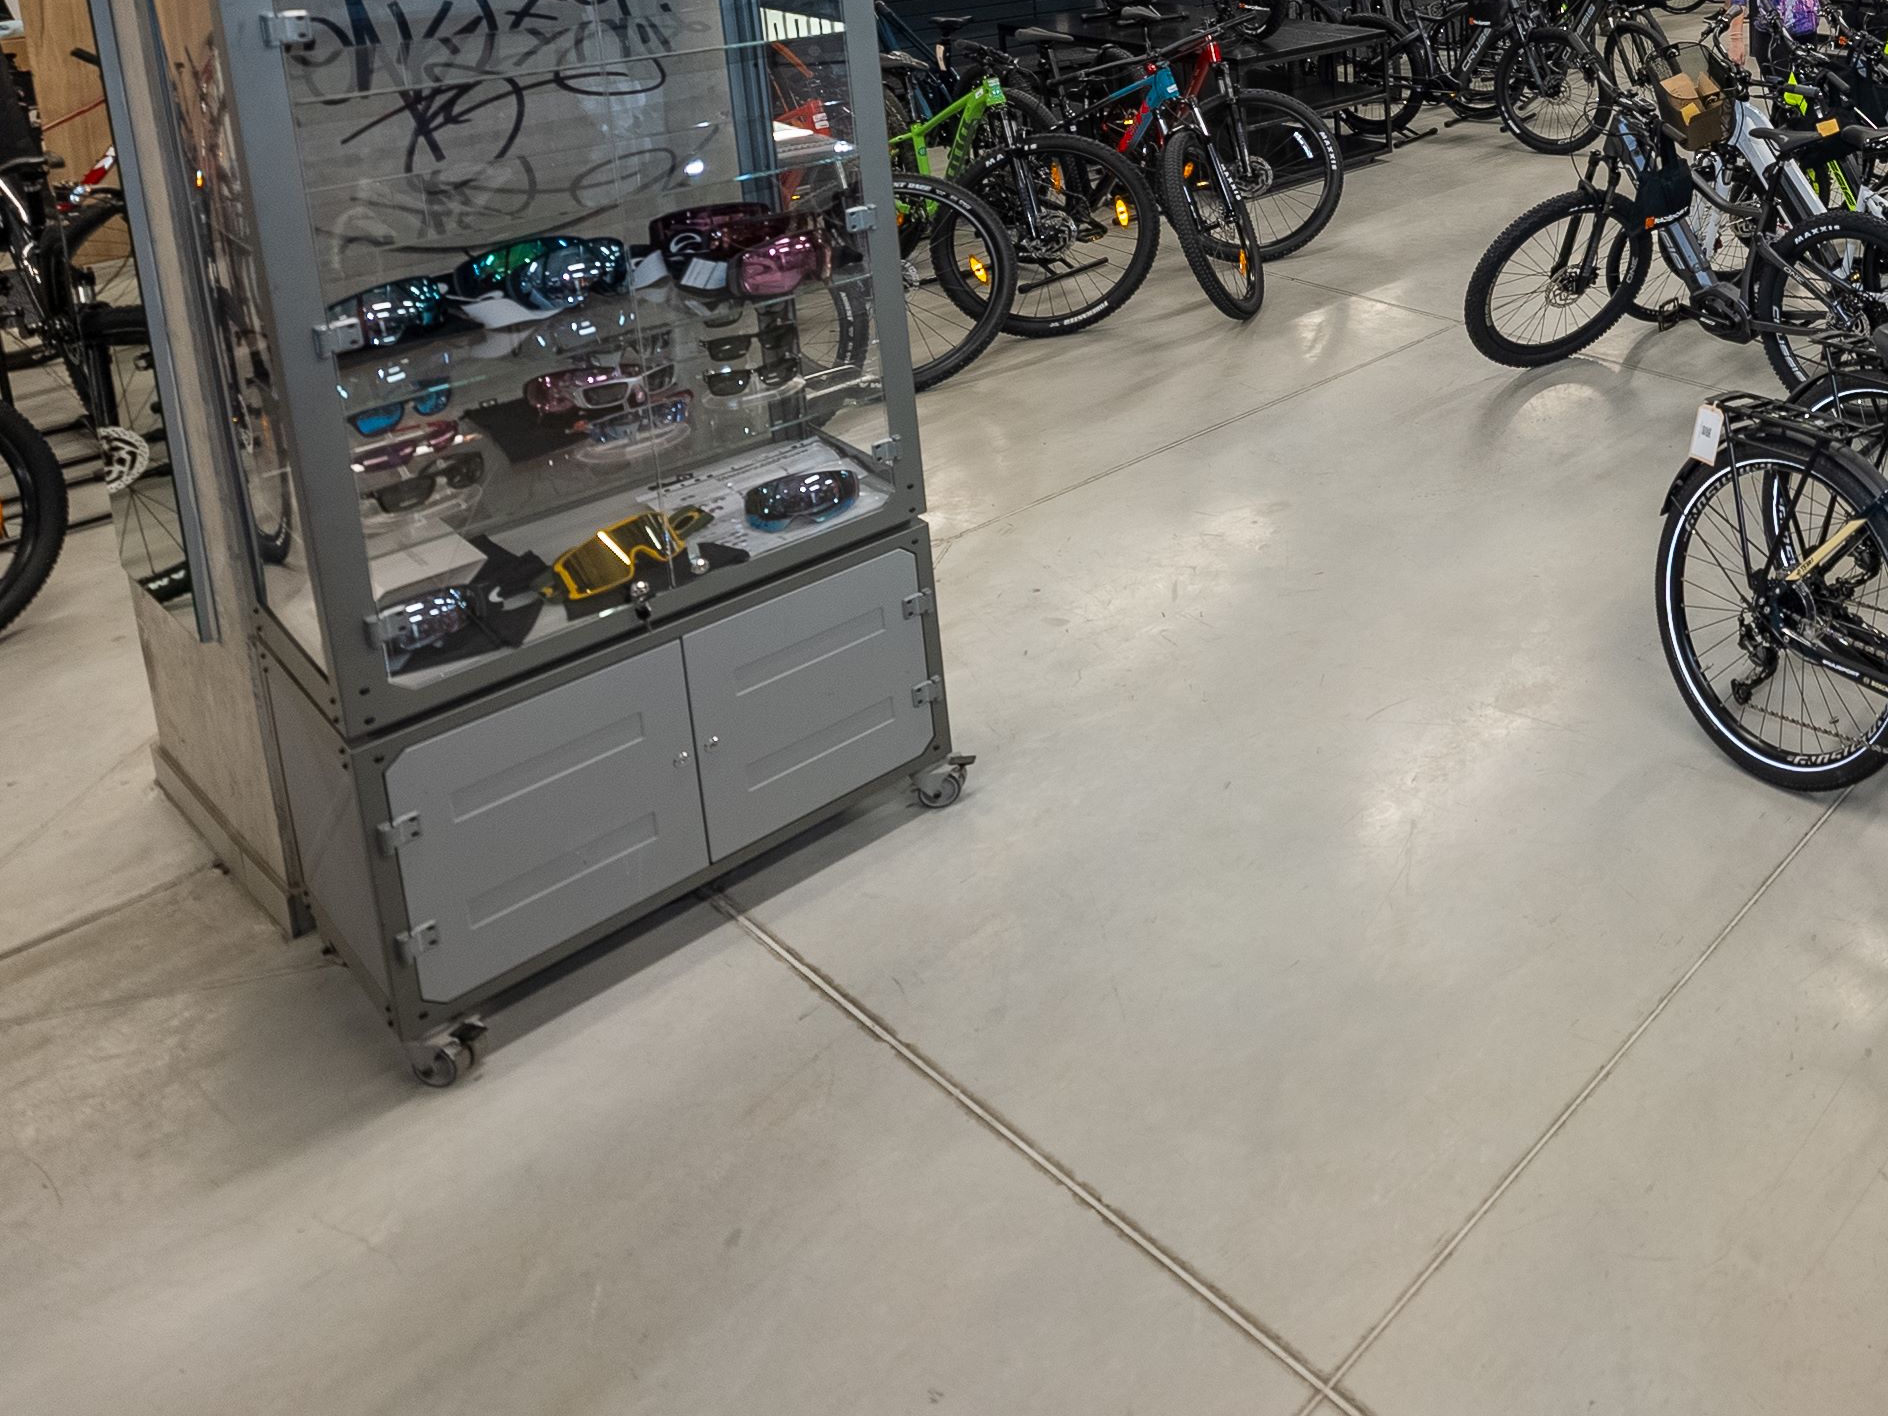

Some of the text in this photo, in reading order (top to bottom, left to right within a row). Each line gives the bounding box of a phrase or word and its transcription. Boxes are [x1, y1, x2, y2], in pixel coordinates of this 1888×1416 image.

[985, 143, 1038, 168] MAIS
[1319, 131, 1338, 171] MAXXIS
[1794, 223, 1840, 245] MAXXIS
